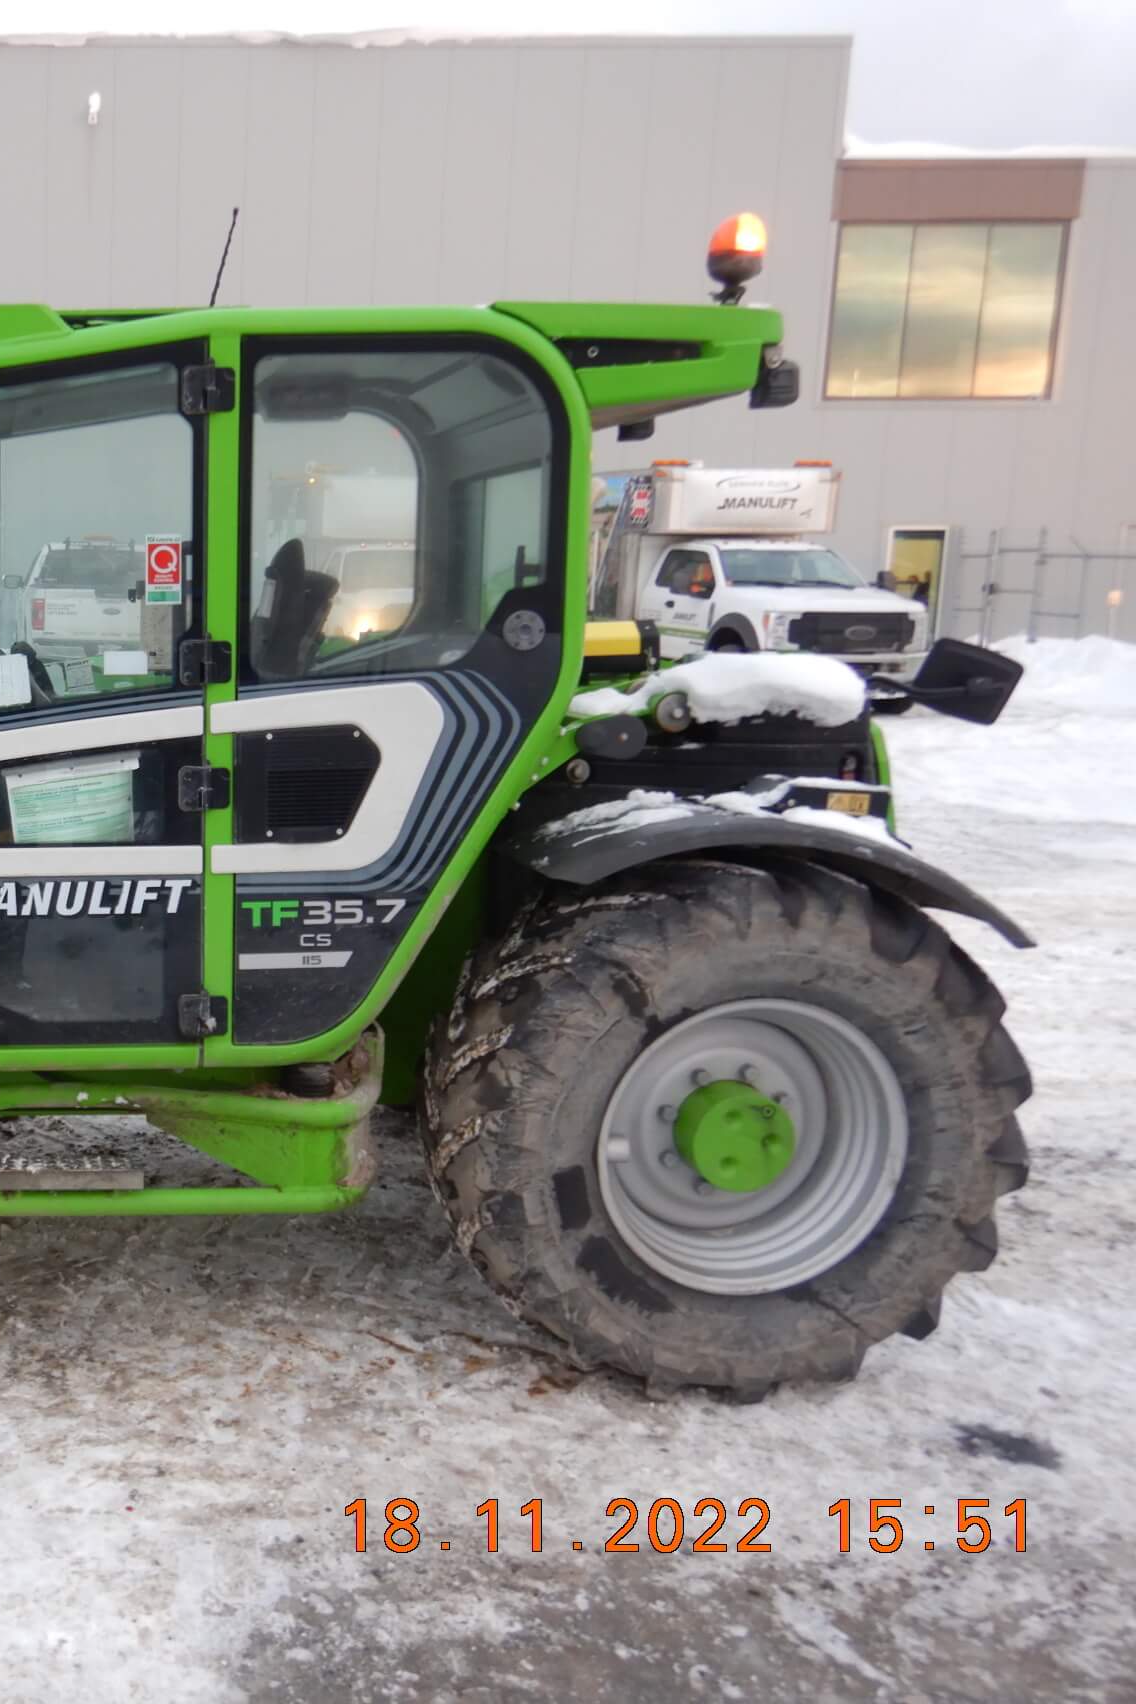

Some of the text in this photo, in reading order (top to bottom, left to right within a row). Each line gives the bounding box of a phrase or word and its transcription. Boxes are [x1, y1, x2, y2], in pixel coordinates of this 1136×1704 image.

[716, 497, 799, 511] MANULIFT
[150, 545, 178, 574] Q
[241, 898, 407, 928] TF35.7
[299, 933, 332, 947] CS
